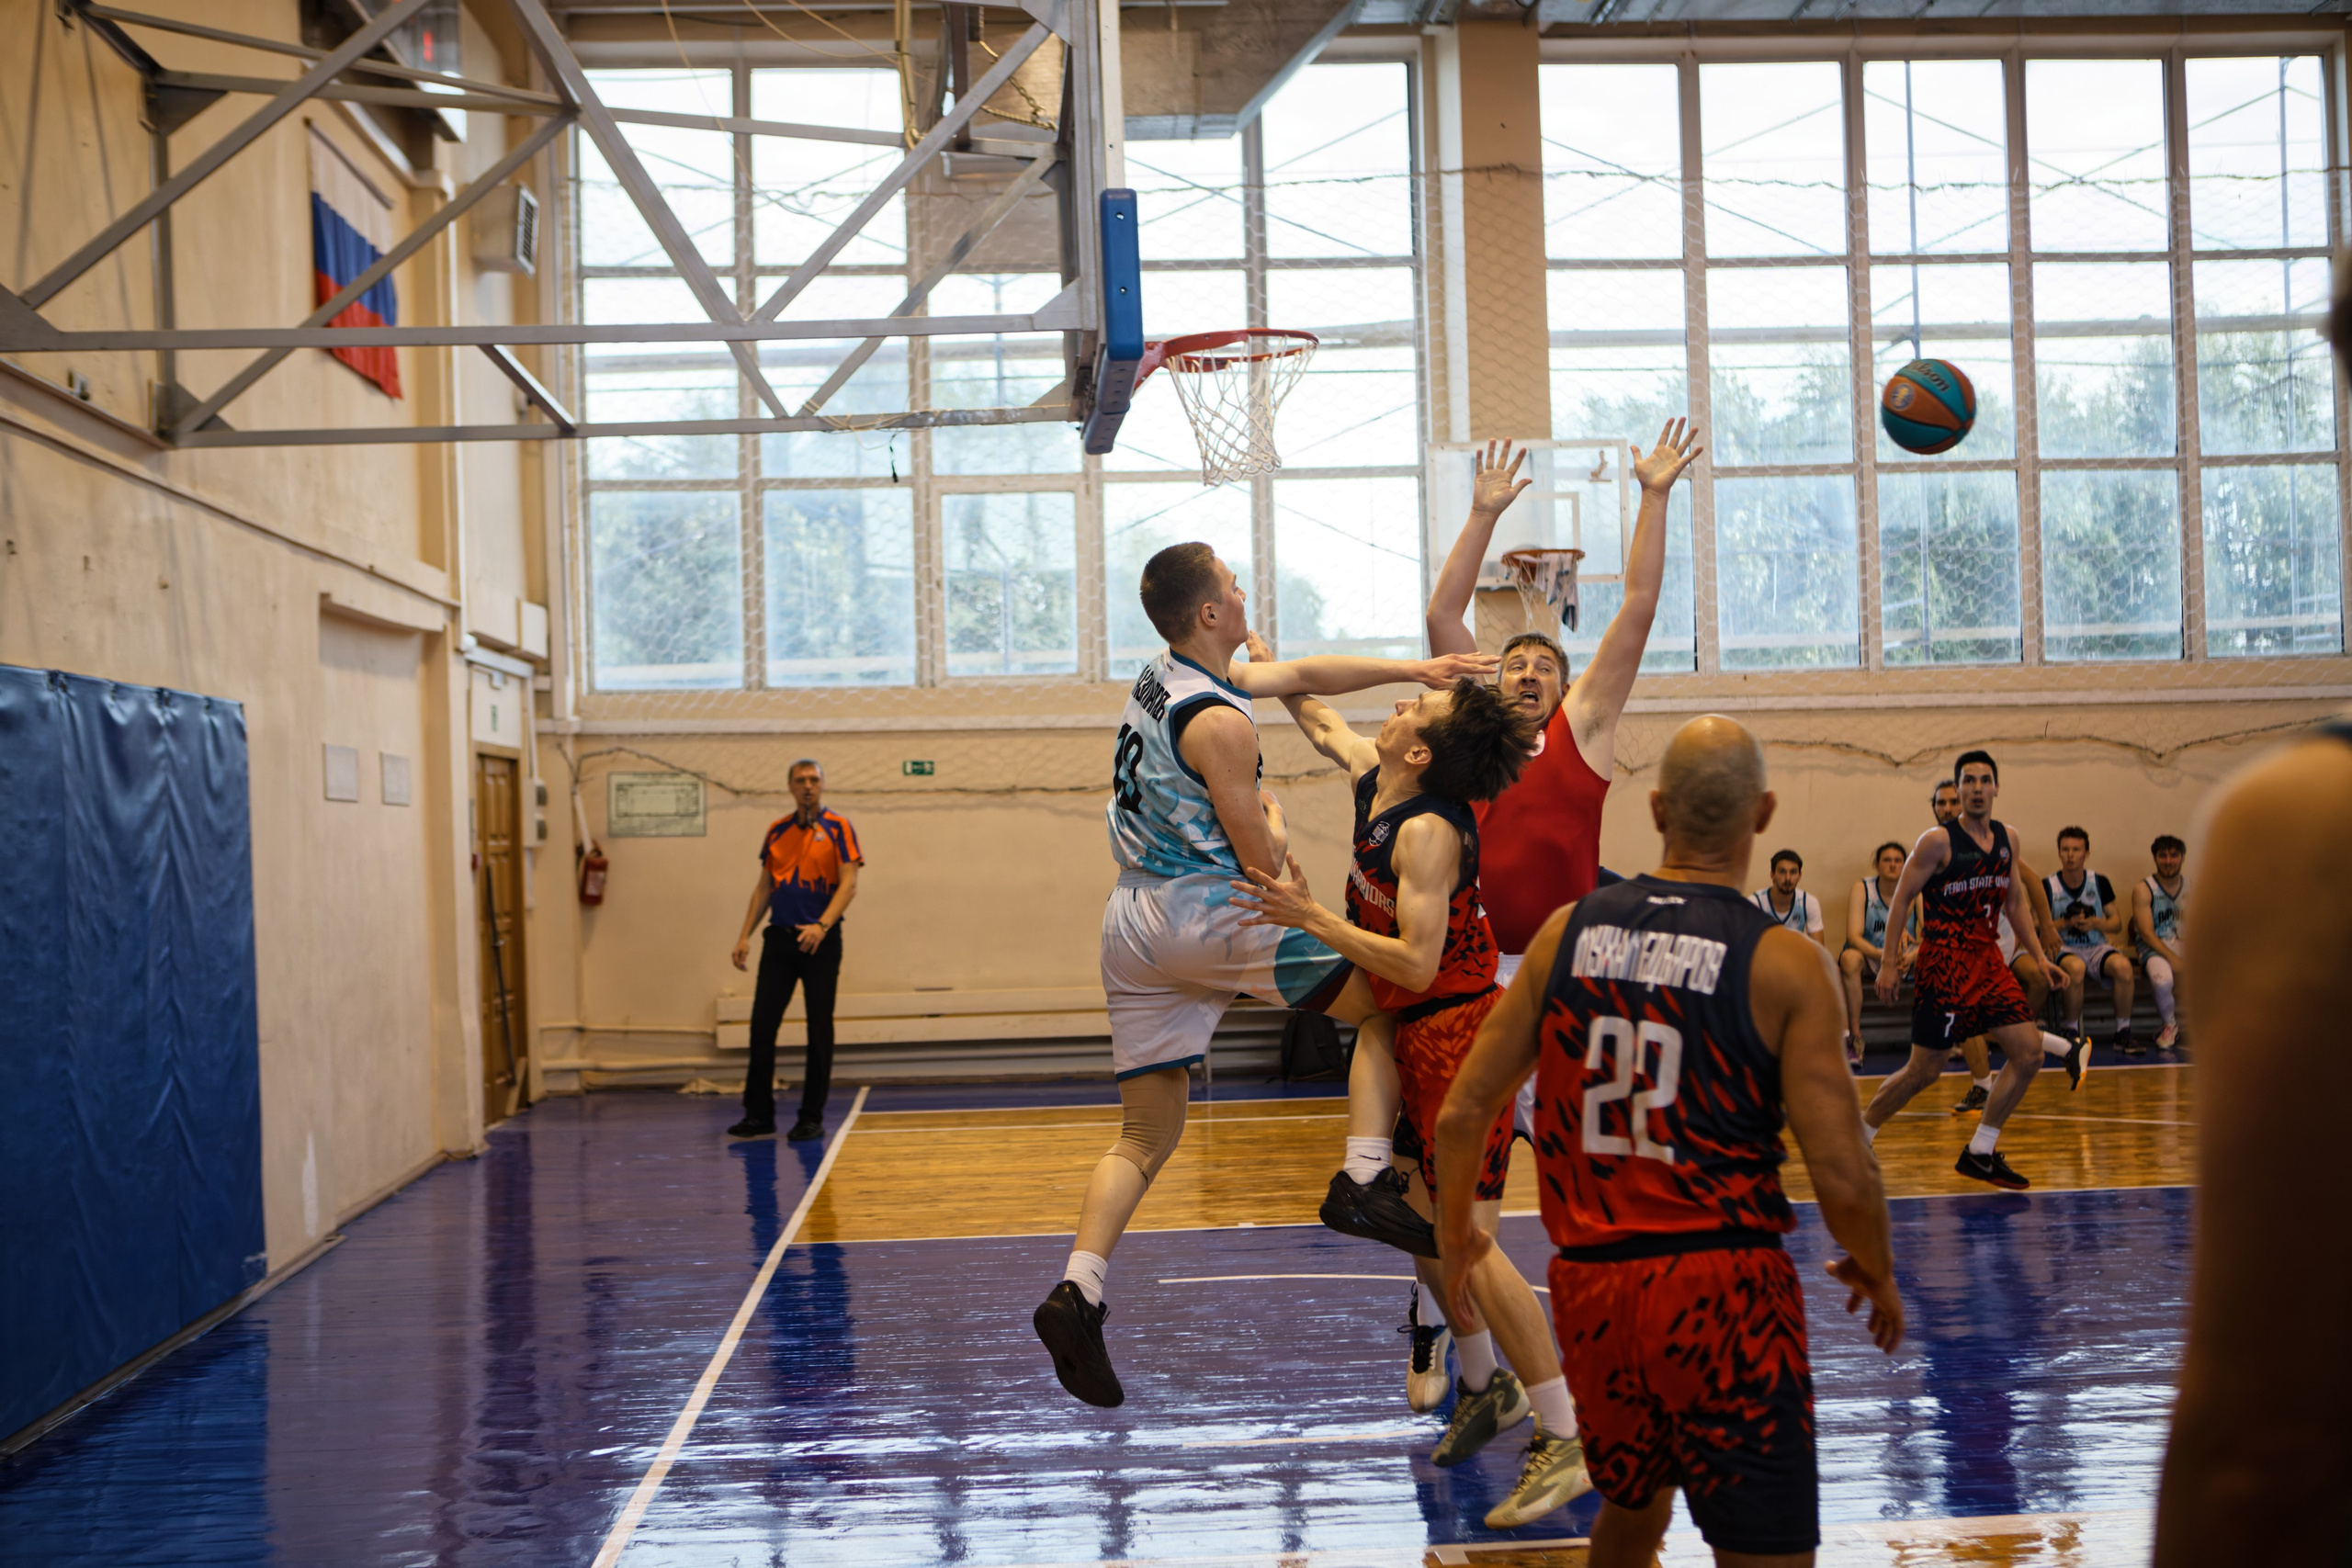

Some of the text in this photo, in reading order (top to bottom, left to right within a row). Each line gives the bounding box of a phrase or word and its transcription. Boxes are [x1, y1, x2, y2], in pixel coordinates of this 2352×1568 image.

[1943, 879, 1968, 897] PERM
[1969, 875, 1994, 891] STATE
[1944, 1012, 1956, 1038] 7
[1582, 1015, 1683, 1167] 22
